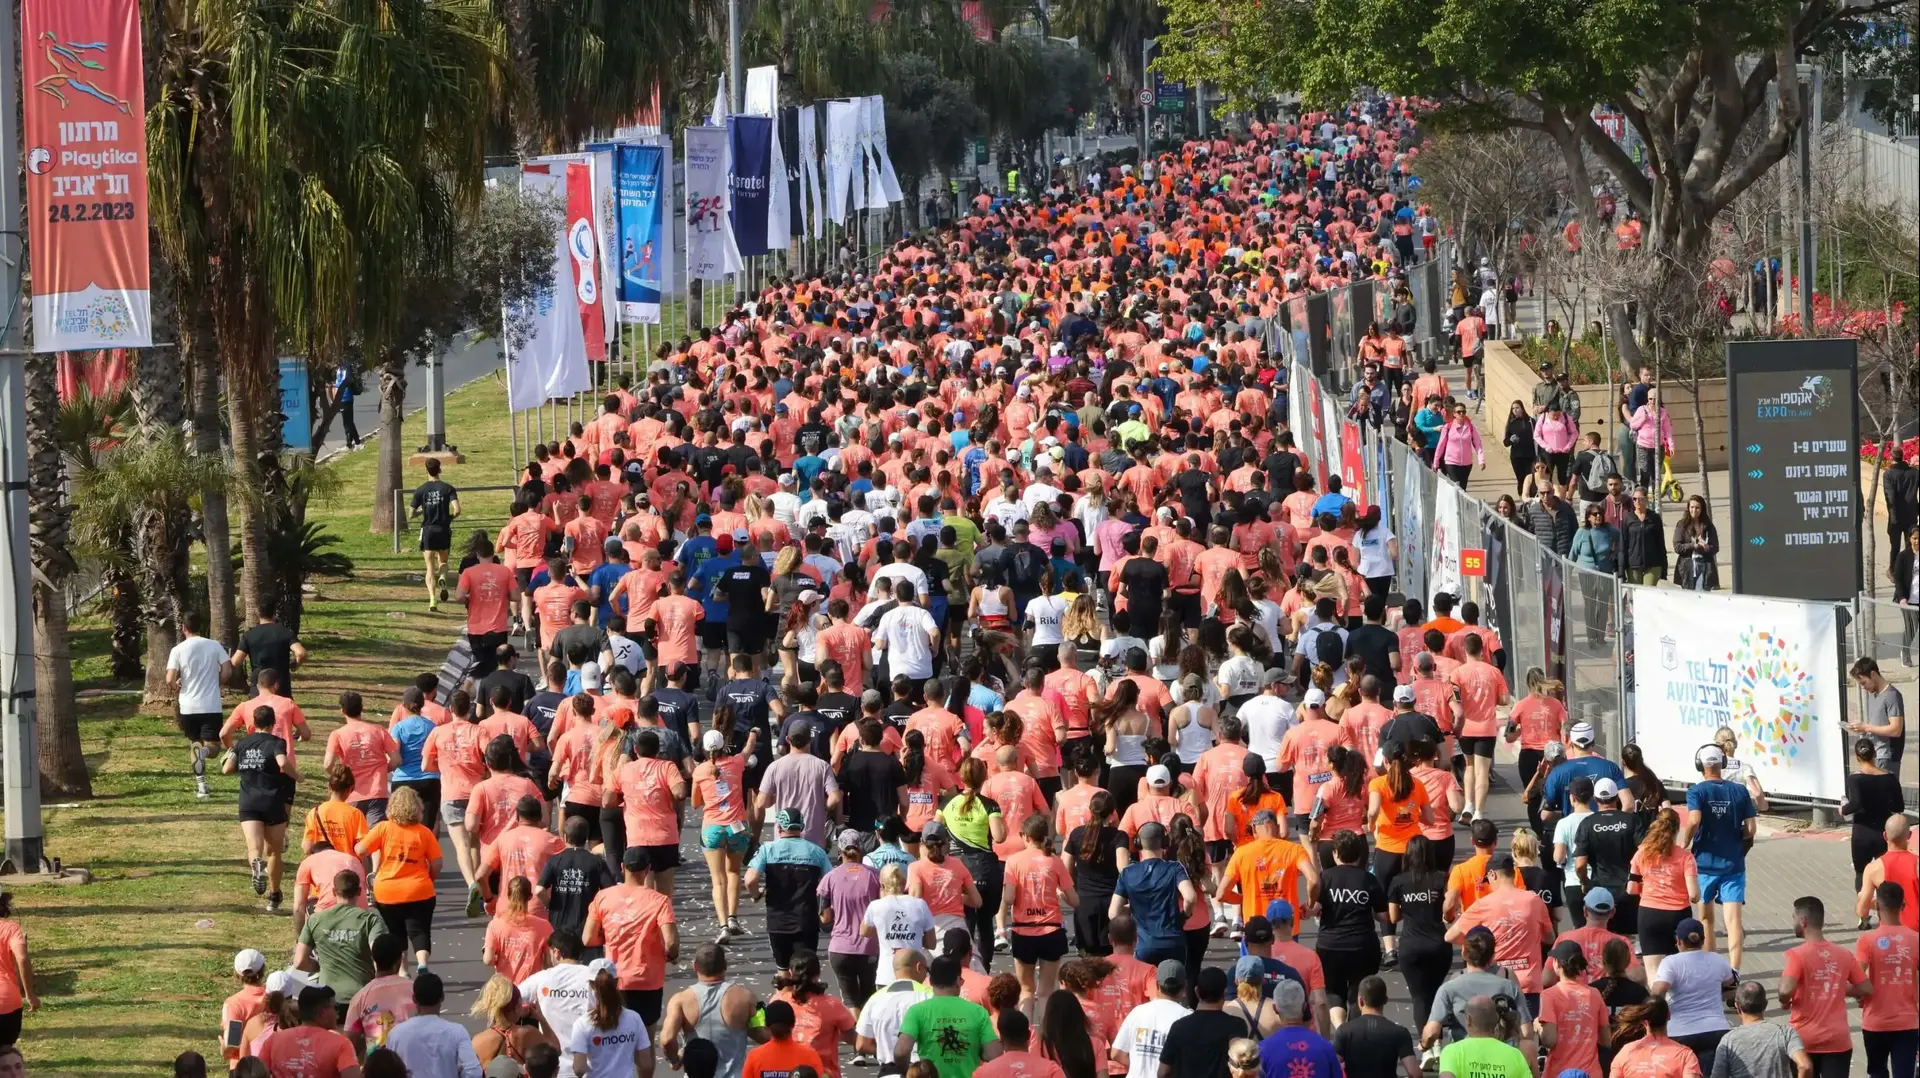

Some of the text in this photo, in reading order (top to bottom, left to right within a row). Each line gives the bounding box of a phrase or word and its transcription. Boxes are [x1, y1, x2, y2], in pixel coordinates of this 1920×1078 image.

[1141, 93, 1151, 101] 50
[59, 121, 118, 145] מרתון
[62, 148, 137, 169] Playtika
[48, 202, 134, 223] 24.2.2023
[1758, 397, 1771, 405] אביב
[1781, 392, 1812, 406] אקספו
[1757, 406, 1787, 418] EXPO
[1812, 440, 1846, 452] שערים
[1785, 464, 1847, 478] אקספו ביזנס
[1794, 490, 1848, 504] חניון הגשר
[1803, 506, 1848, 520] דרייב אין
[1785, 531, 1849, 545] היכל הספורט
[1465, 557, 1481, 568] 55
[1040, 617, 1058, 625] Riki
[1685, 658, 1728, 684] TEL תל
[1667, 681, 1729, 707] AVIV אביב
[1679, 705, 1731, 728] YAFO יפו
[1593, 822, 1627, 832] Google
[1329, 888, 1369, 904] WXG
[1403, 892, 1428, 902] WXG
[1026, 908, 1047, 916] DANA
[885, 932, 916, 941] RUNNER
[549, 988, 588, 998] moovit
[601, 1032, 635, 1045] moovit
